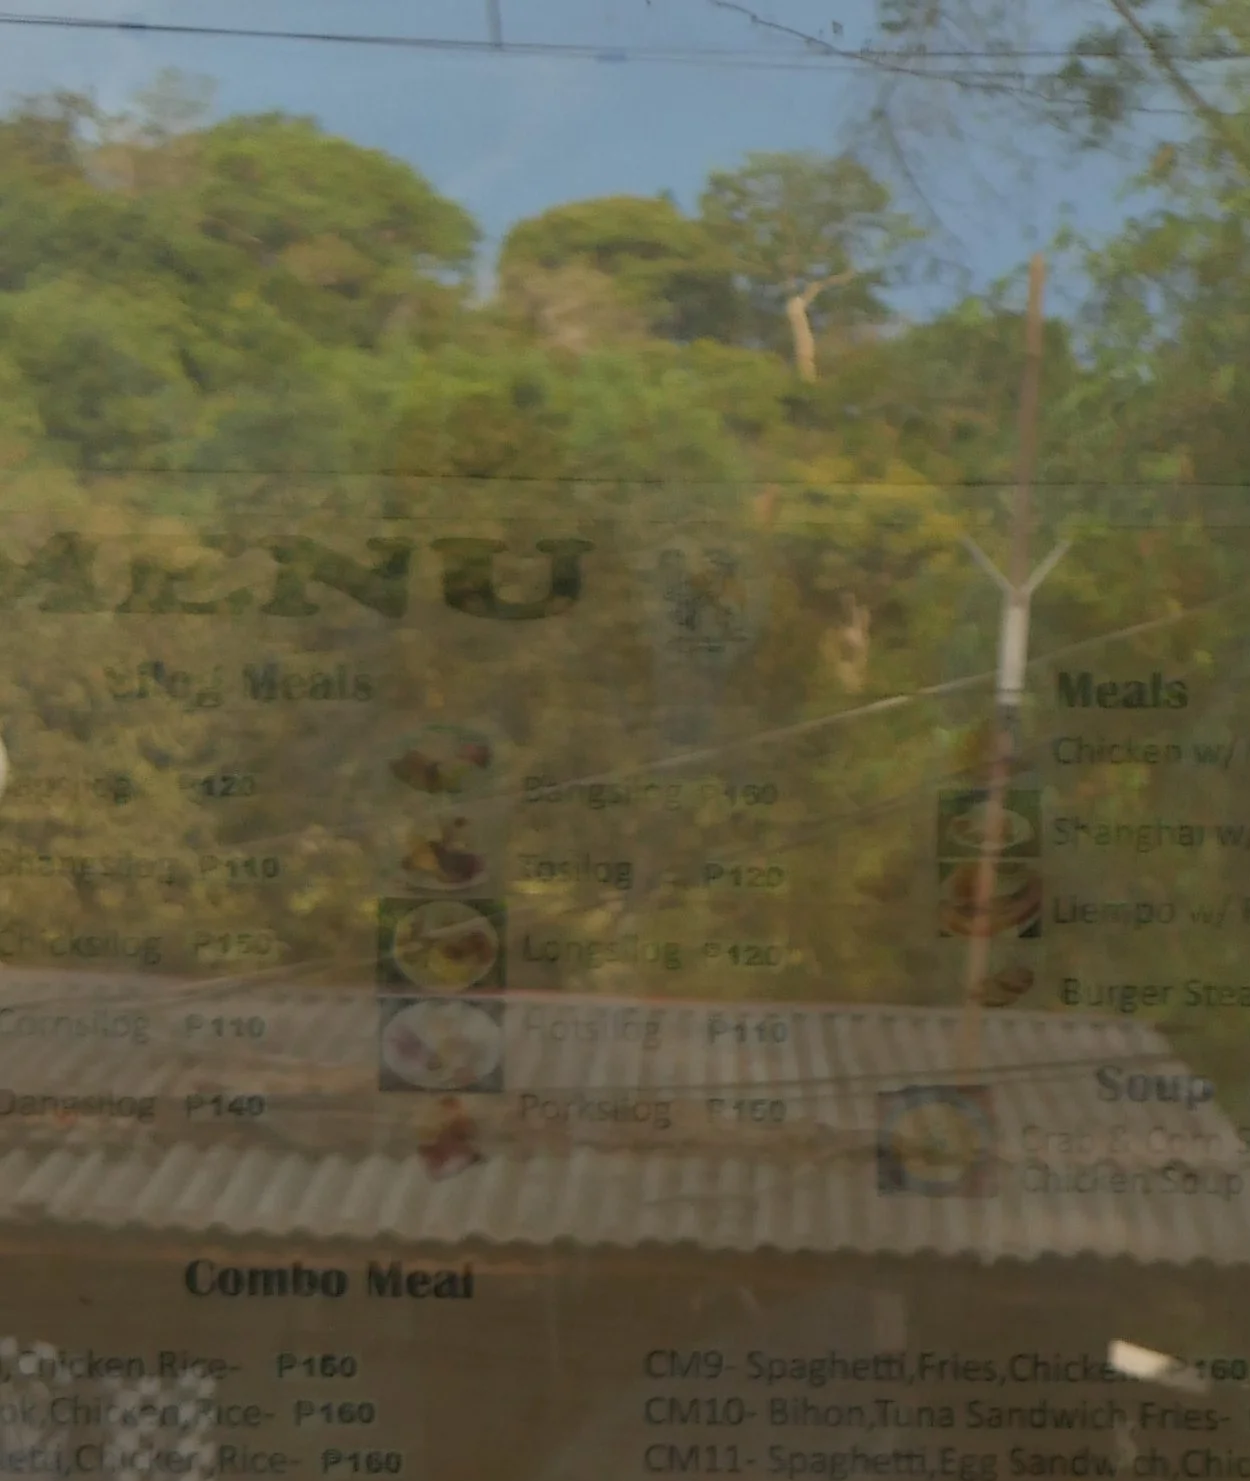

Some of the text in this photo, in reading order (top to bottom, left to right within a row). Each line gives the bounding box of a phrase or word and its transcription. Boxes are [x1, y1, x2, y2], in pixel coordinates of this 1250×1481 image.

[242, 660, 374, 702] Meals
[1056, 672, 1189, 710] Meals
[1053, 737, 1181, 765] Chicken
[1193, 737, 1235, 770] w/
[1053, 816, 1205, 853] Shanghai
[1189, 898, 1231, 926] w/
[1061, 977, 1172, 1010] Burger
[1094, 1065, 1216, 1108] Soup
[185, 1258, 475, 1299] Combo Meal
[644, 1349, 737, 1380] CM9-
[645, 1397, 758, 1426] CM10-
[645, 1444, 758, 1473] CM11-
